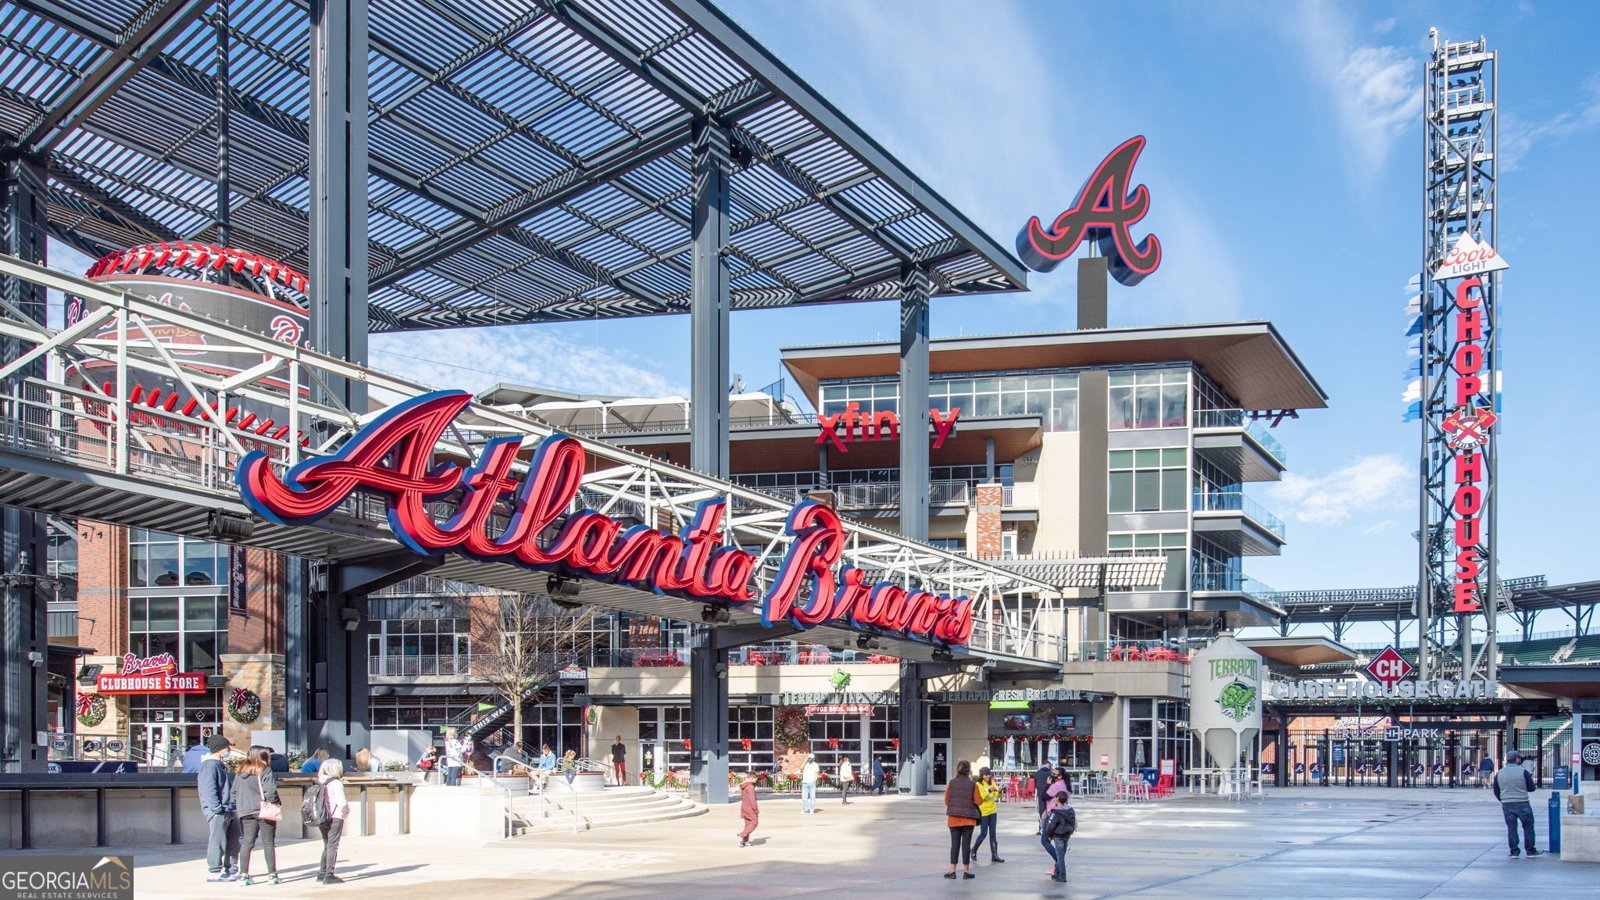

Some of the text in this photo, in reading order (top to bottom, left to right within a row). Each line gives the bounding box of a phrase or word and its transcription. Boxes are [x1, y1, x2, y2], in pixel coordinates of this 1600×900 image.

[1443, 247, 1497, 267] Coors
[1452, 260, 1487, 274] LIGHT
[1456, 277, 1482, 406] CHOP
[815, 402, 961, 452] xfiny
[236, 389, 973, 646] Atlanta Braves
[1454, 452, 1482, 612] HOUSE
[122, 652, 169, 676] Braves
[1208, 658, 1257, 680] TERRAPIN
[1376, 660, 1403, 677] CH
[101, 677, 199, 690] CLUBHOUSE STORE
[1271, 680, 1498, 699] CHOP HOUSE GATE
[993, 689, 1024, 701] FRESH
[1026, 688, 1056, 700] BREW
[1059, 689, 1081, 700] BAR
[474, 717, 490, 731] THIS
[491, 705, 508, 719] WAY
[1404, 728, 1439, 739] PARK
